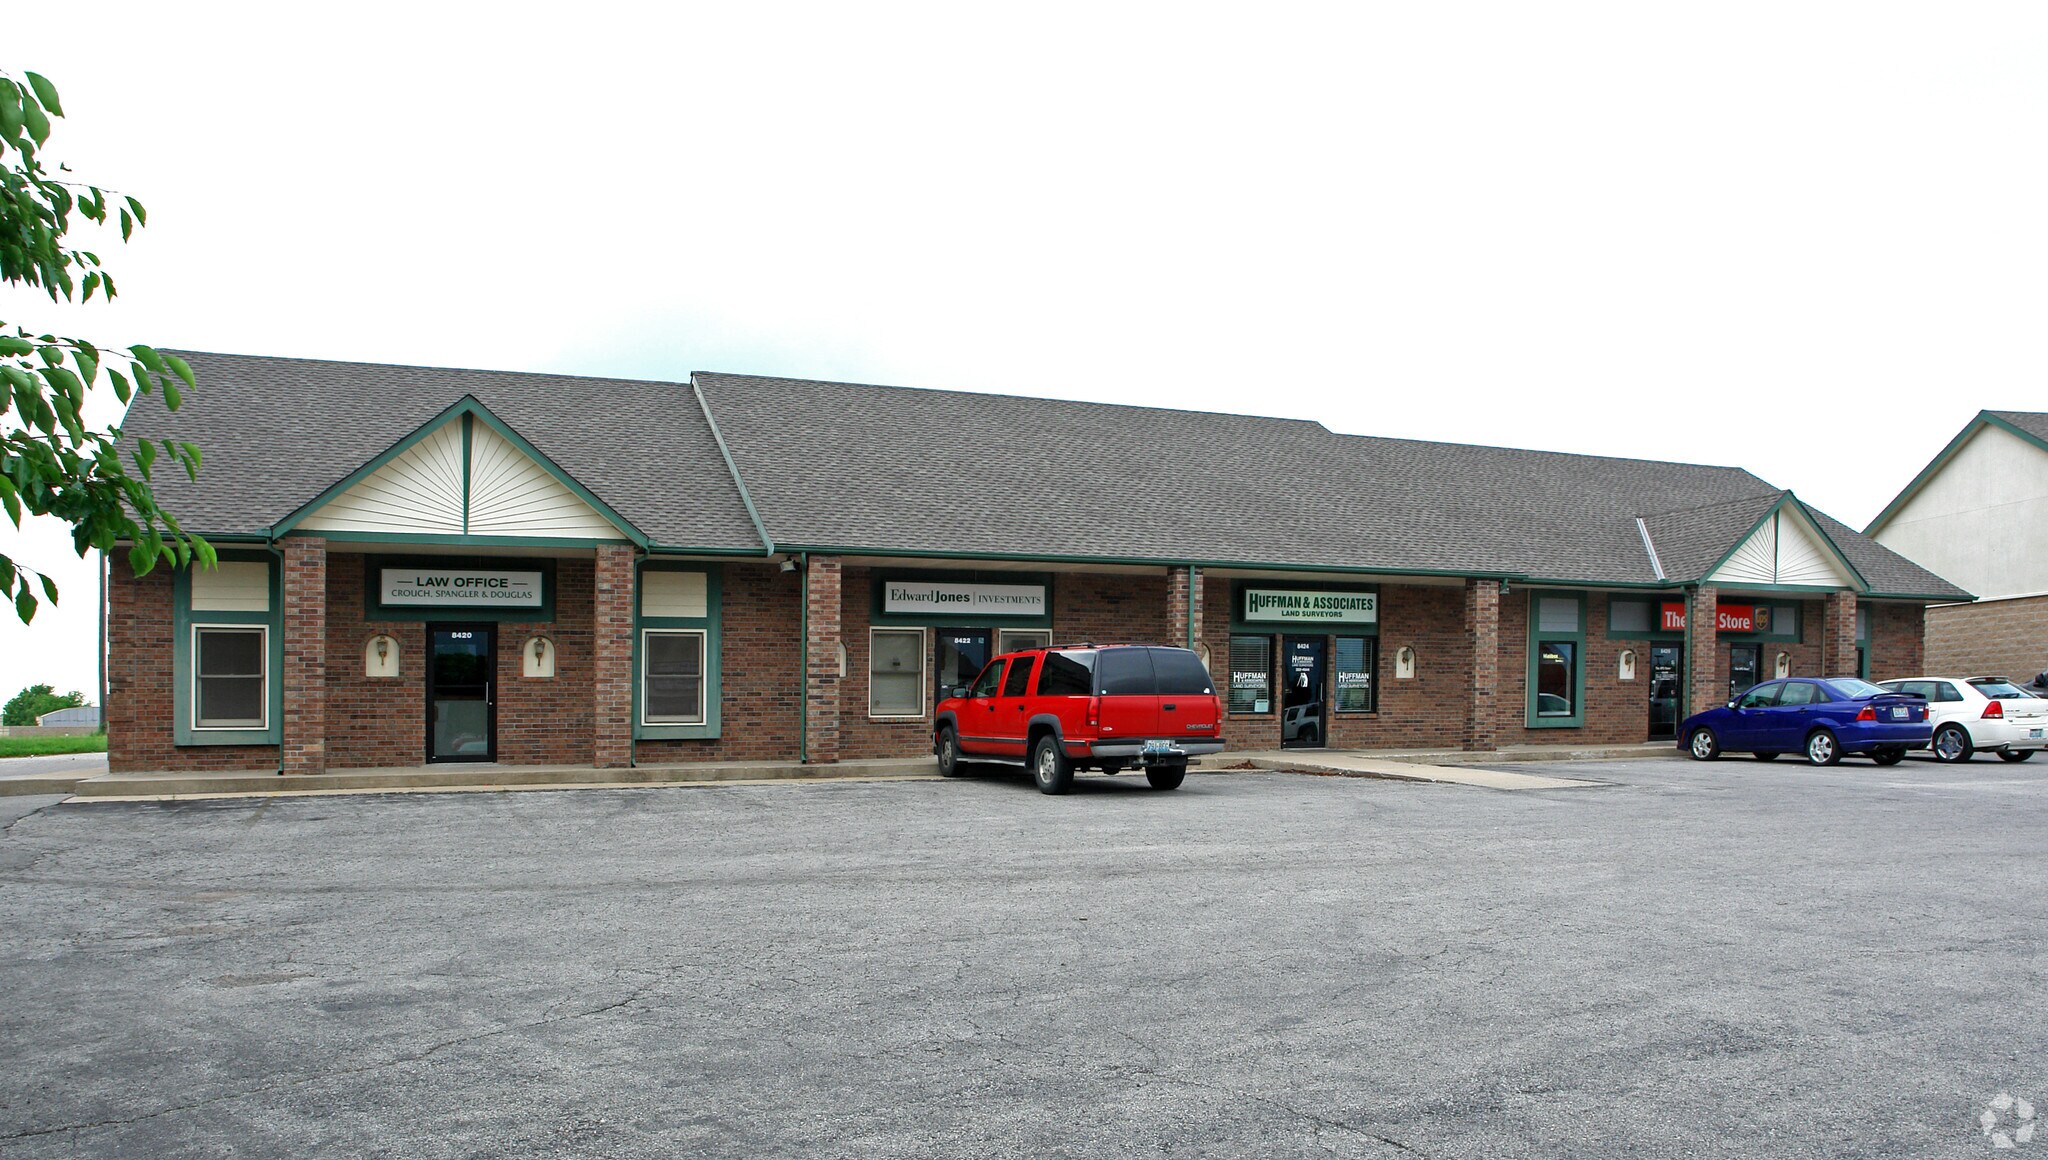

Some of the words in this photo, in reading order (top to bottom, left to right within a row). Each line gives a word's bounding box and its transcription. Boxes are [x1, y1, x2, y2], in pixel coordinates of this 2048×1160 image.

[416, 576, 449, 587] LAW
[454, 577, 509, 588] OFFICE
[391, 589, 433, 598] CROUCH,
[435, 589, 479, 598] SPANGLER
[481, 590, 488, 598] &
[490, 590, 532, 599] DOUGLAS
[890, 589, 934, 602] Edward
[934, 591, 970, 603] Jones
[978, 595, 1041, 605] INVESTMENTS
[1249, 593, 1301, 612] HUFFMAN
[1302, 597, 1311, 609] &
[1313, 597, 1374, 611] ASSOCIATES
[1665, 611, 1685, 628] The
[1719, 613, 1751, 629] Store
[1233, 671, 1267, 683] HUFFMAN
[1338, 671, 1370, 683] HUFFMAN
